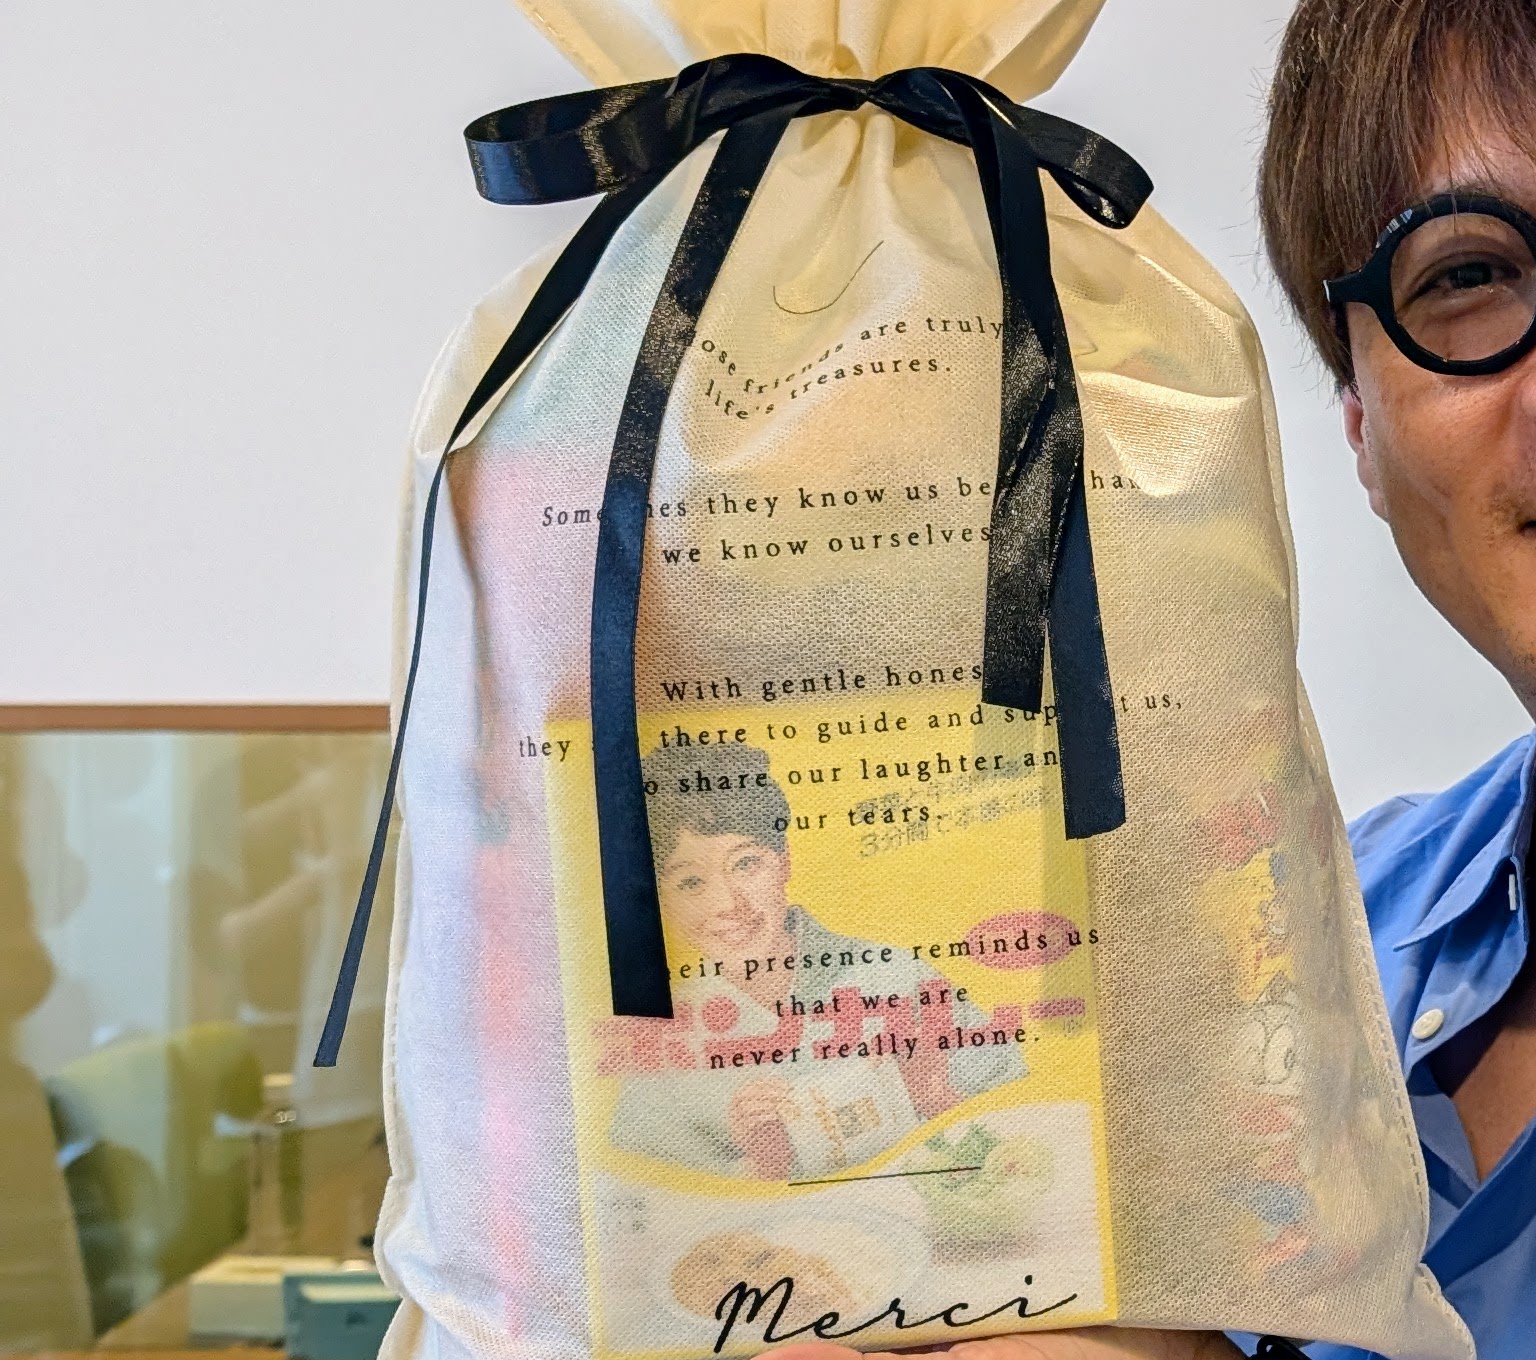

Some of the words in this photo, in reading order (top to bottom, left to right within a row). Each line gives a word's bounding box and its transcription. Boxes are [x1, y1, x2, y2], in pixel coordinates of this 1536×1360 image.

[701, 338, 737, 377] ose
[743, 343, 843, 395] friends
[860, 320, 907, 341] are
[925, 316, 1003, 340] truly
[704, 379, 775, 420] life's
[790, 357, 951, 400] treasures.
[707, 493, 778, 518] they
[798, 487, 885, 509] know
[906, 483, 938, 501] us
[663, 546, 701, 564] we
[721, 539, 808, 561] know
[828, 524, 993, 552] ourselves
[661, 677, 743, 702] With
[762, 669, 866, 702] gentle
[519, 736, 571, 762] they
[661, 725, 747, 749] there
[767, 723, 797, 741] to
[817, 712, 907, 744] guide
[928, 704, 984, 729] and
[1145, 694, 1182, 710] us,
[679, 771, 768, 795] share
[788, 766, 842, 785] our
[861, 752, 1004, 782] laughter
[774, 815, 828, 833] our
[848, 805, 943, 827] tears.
[669, 957, 724, 980] eir
[744, 947, 893, 981] presence
[912, 930, 1048, 960] reminds
[1067, 929, 1099, 946] us
[776, 995, 841, 1018] that
[859, 994, 900, 1011] we
[919, 987, 968, 1006] are
[710, 1047, 801, 1070] never
[822, 1034, 917, 1060] really
[938, 1027, 1039, 1050] alone.
[713, 1274, 1078, 1353] Merci
